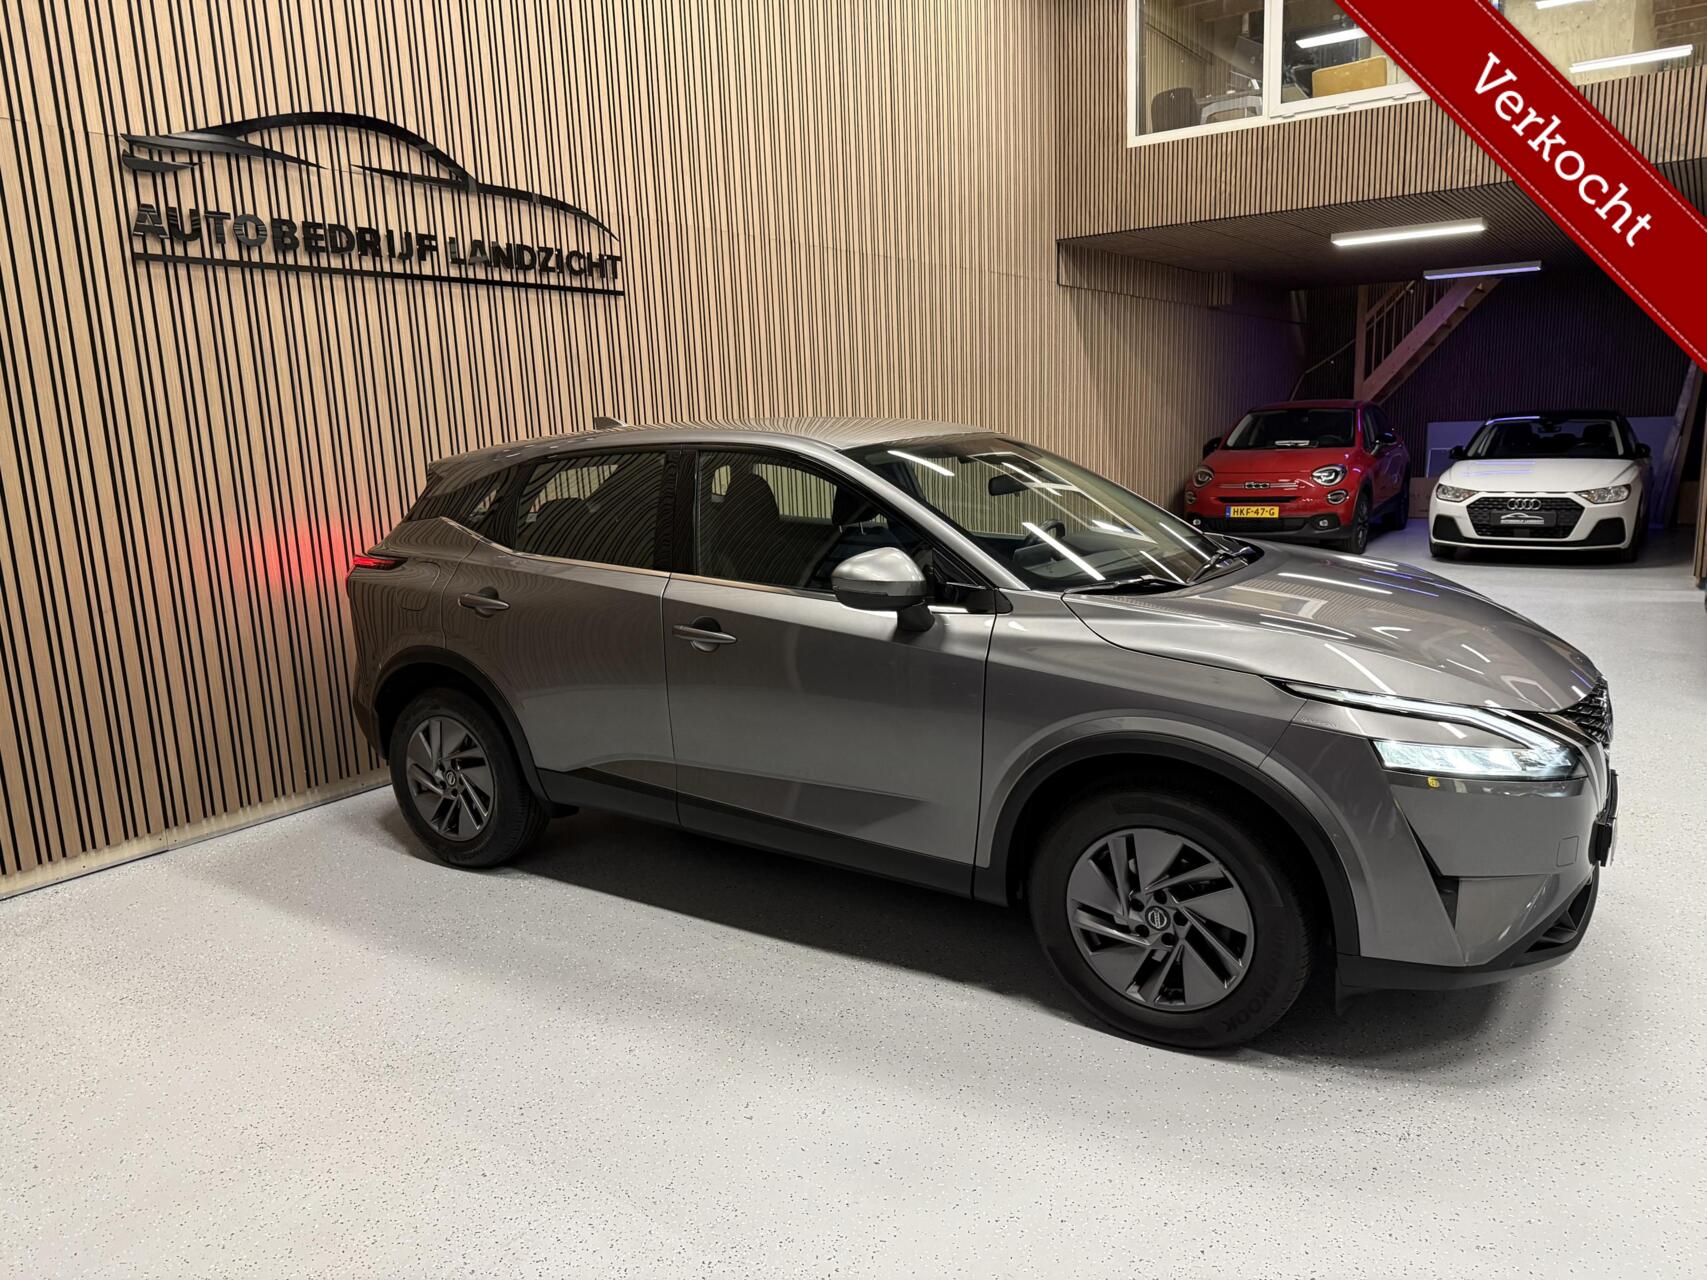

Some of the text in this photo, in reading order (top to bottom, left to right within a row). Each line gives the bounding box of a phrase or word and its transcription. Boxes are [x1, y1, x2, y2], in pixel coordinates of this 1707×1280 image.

[133, 202, 622, 279] AUTOBEDRIJF LANDZICHT
[1232, 507, 1275, 517] HKF-47-G
